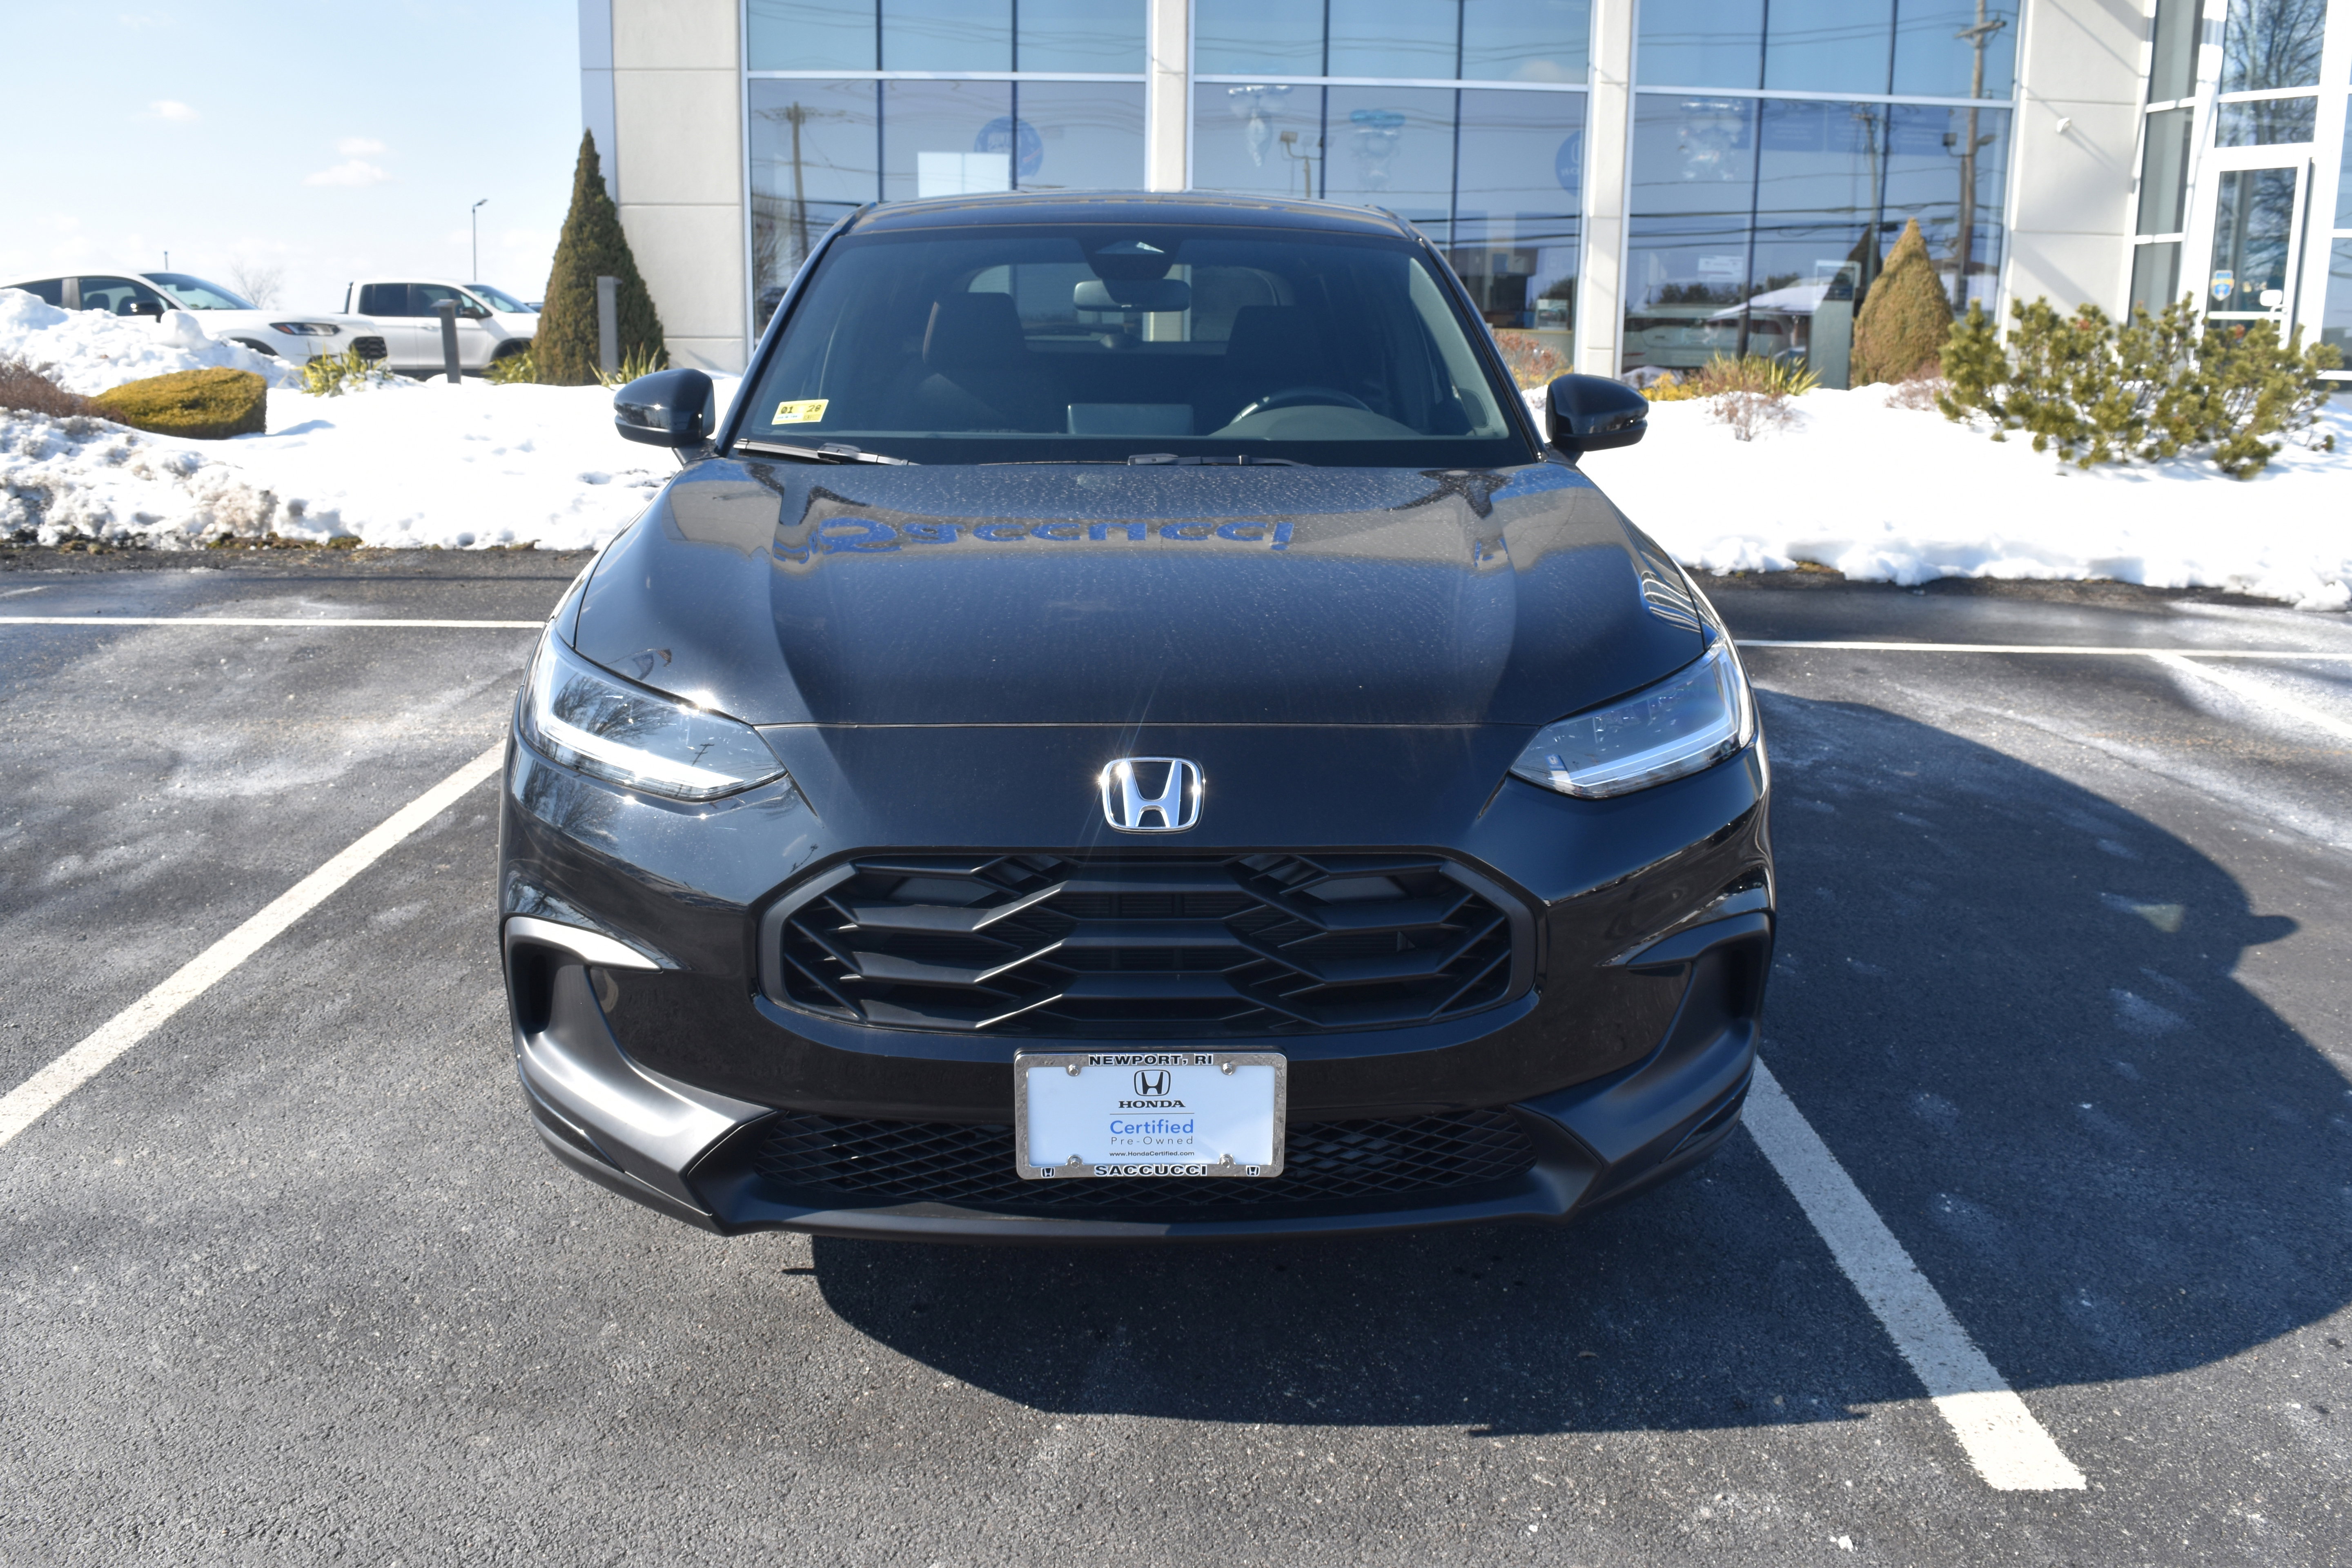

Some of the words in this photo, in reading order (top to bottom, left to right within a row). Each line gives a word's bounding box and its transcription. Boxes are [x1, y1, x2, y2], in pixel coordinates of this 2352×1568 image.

[1088, 1054, 1188, 1066] NEWPORT,
[1194, 1054, 1214, 1065] RI
[1118, 1100, 1186, 1108] HONDA
[1110, 1119, 1194, 1134] Certified
[1111, 1136, 1193, 1145] Pre-Owned
[1094, 1165, 1207, 1176] SACCUCCI
